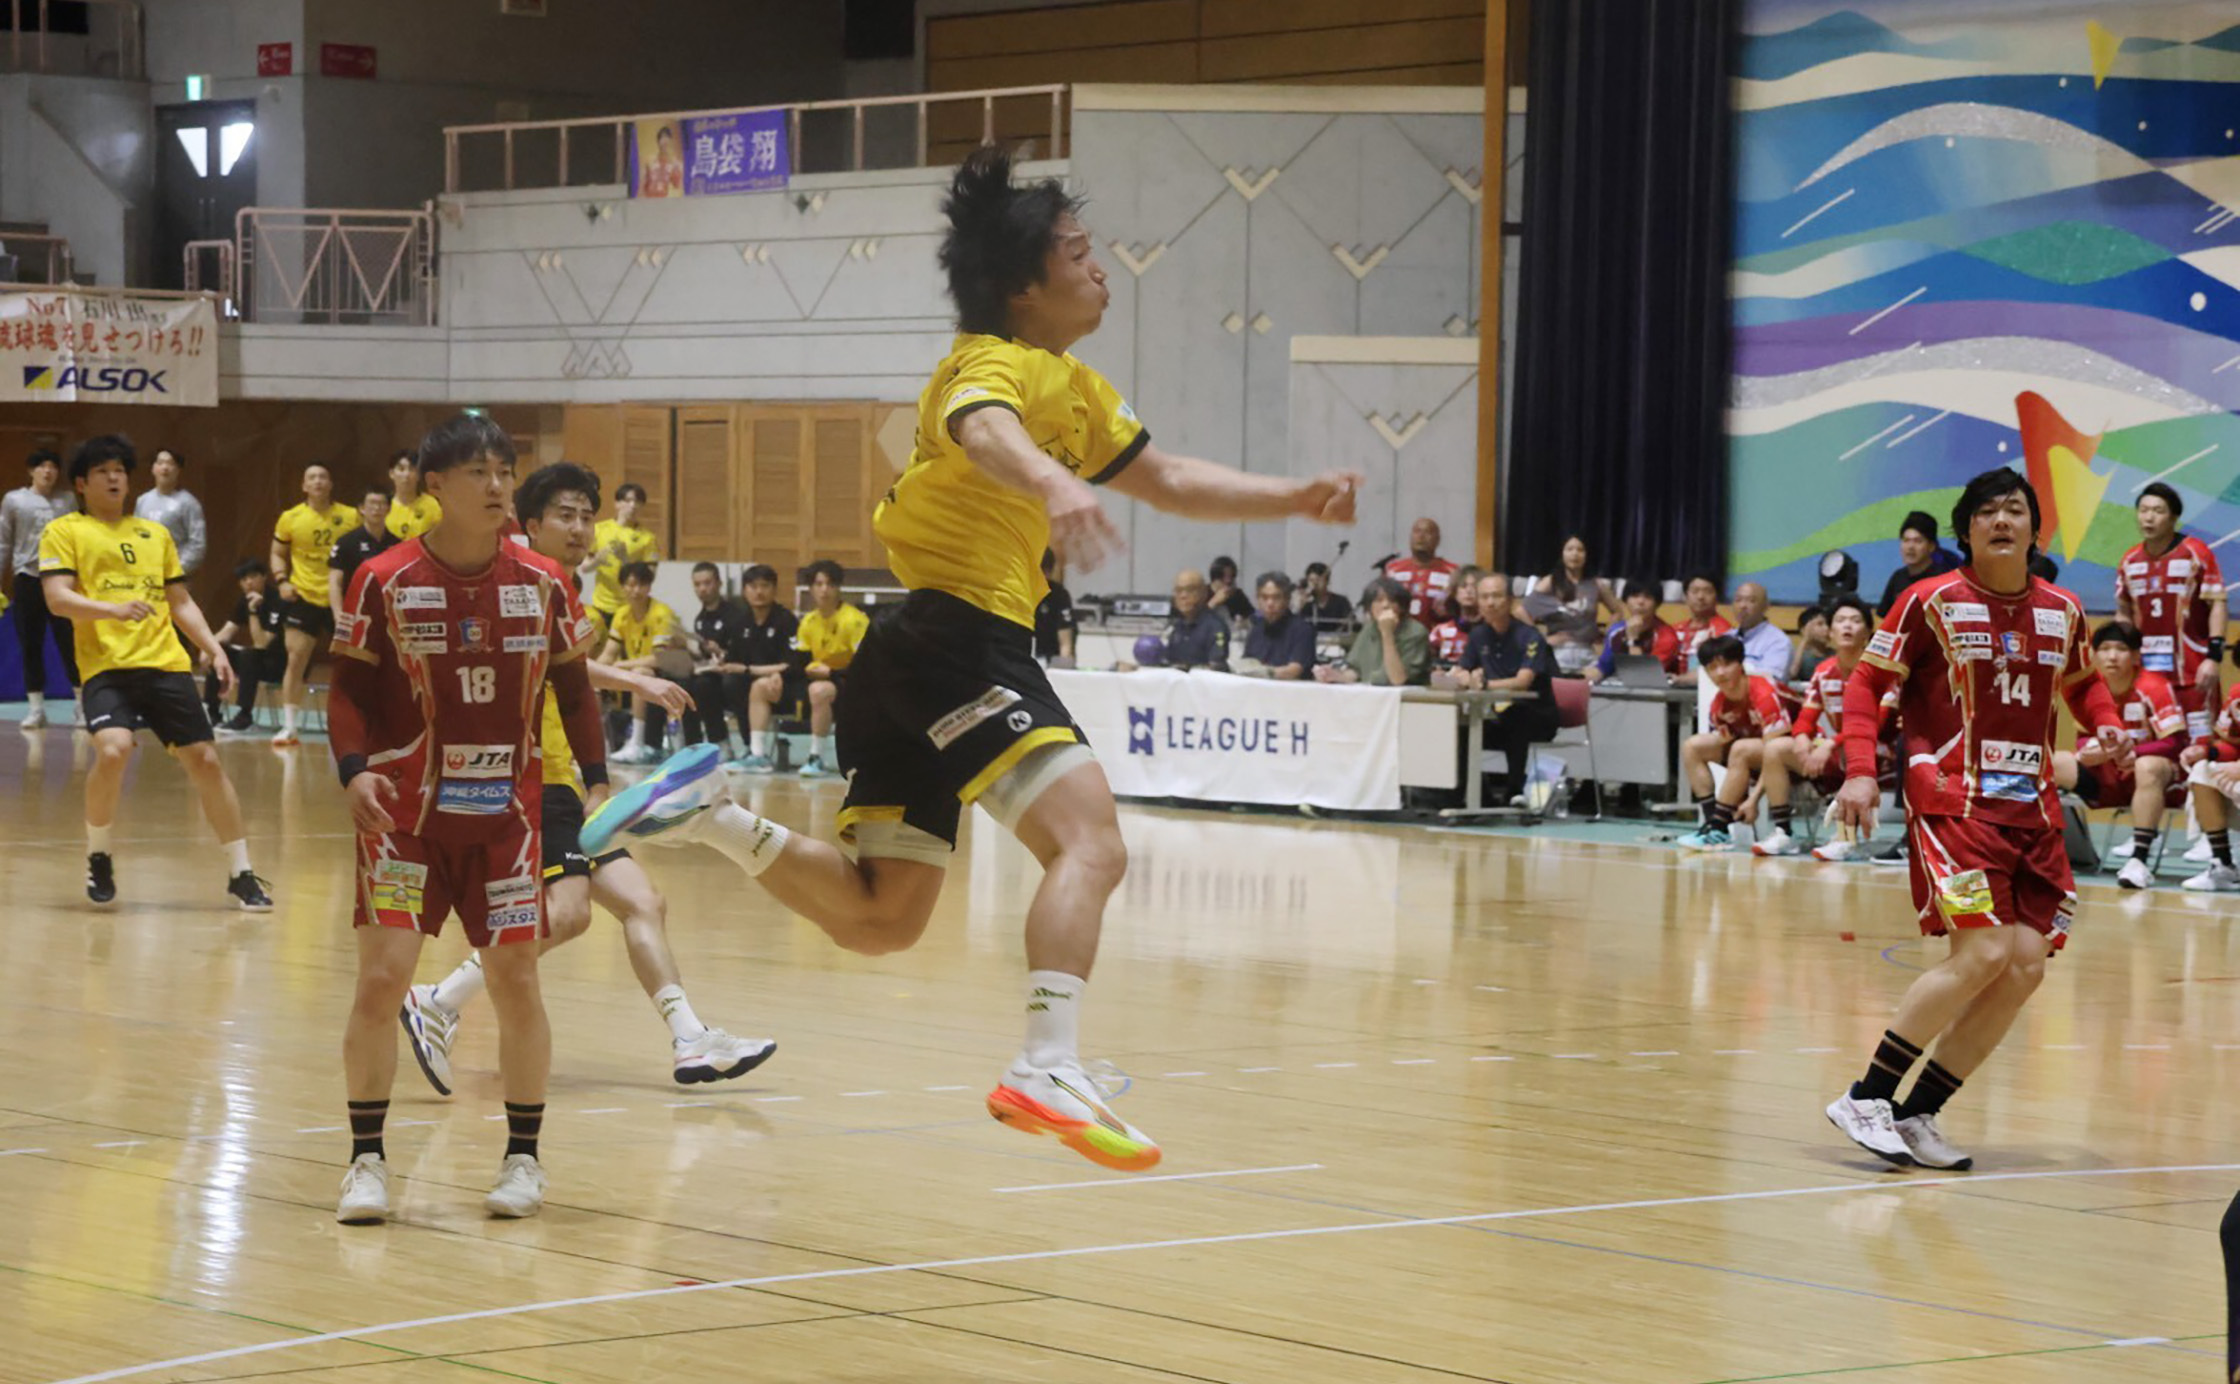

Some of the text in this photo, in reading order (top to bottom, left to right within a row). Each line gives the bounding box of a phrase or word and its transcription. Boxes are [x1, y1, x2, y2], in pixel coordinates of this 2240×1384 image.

[56, 366, 169, 393] ALSOK
[313, 529, 333, 546] 22
[120, 542, 137, 565] 6
[2150, 598, 2163, 618] 3
[455, 666, 496, 704] 18
[1993, 671, 2031, 707] 14
[1166, 715, 1278, 753] LEAGUE
[1291, 721, 1308, 755] H
[467, 751, 511, 766] JTA
[2005, 748, 2040, 764] JTA
